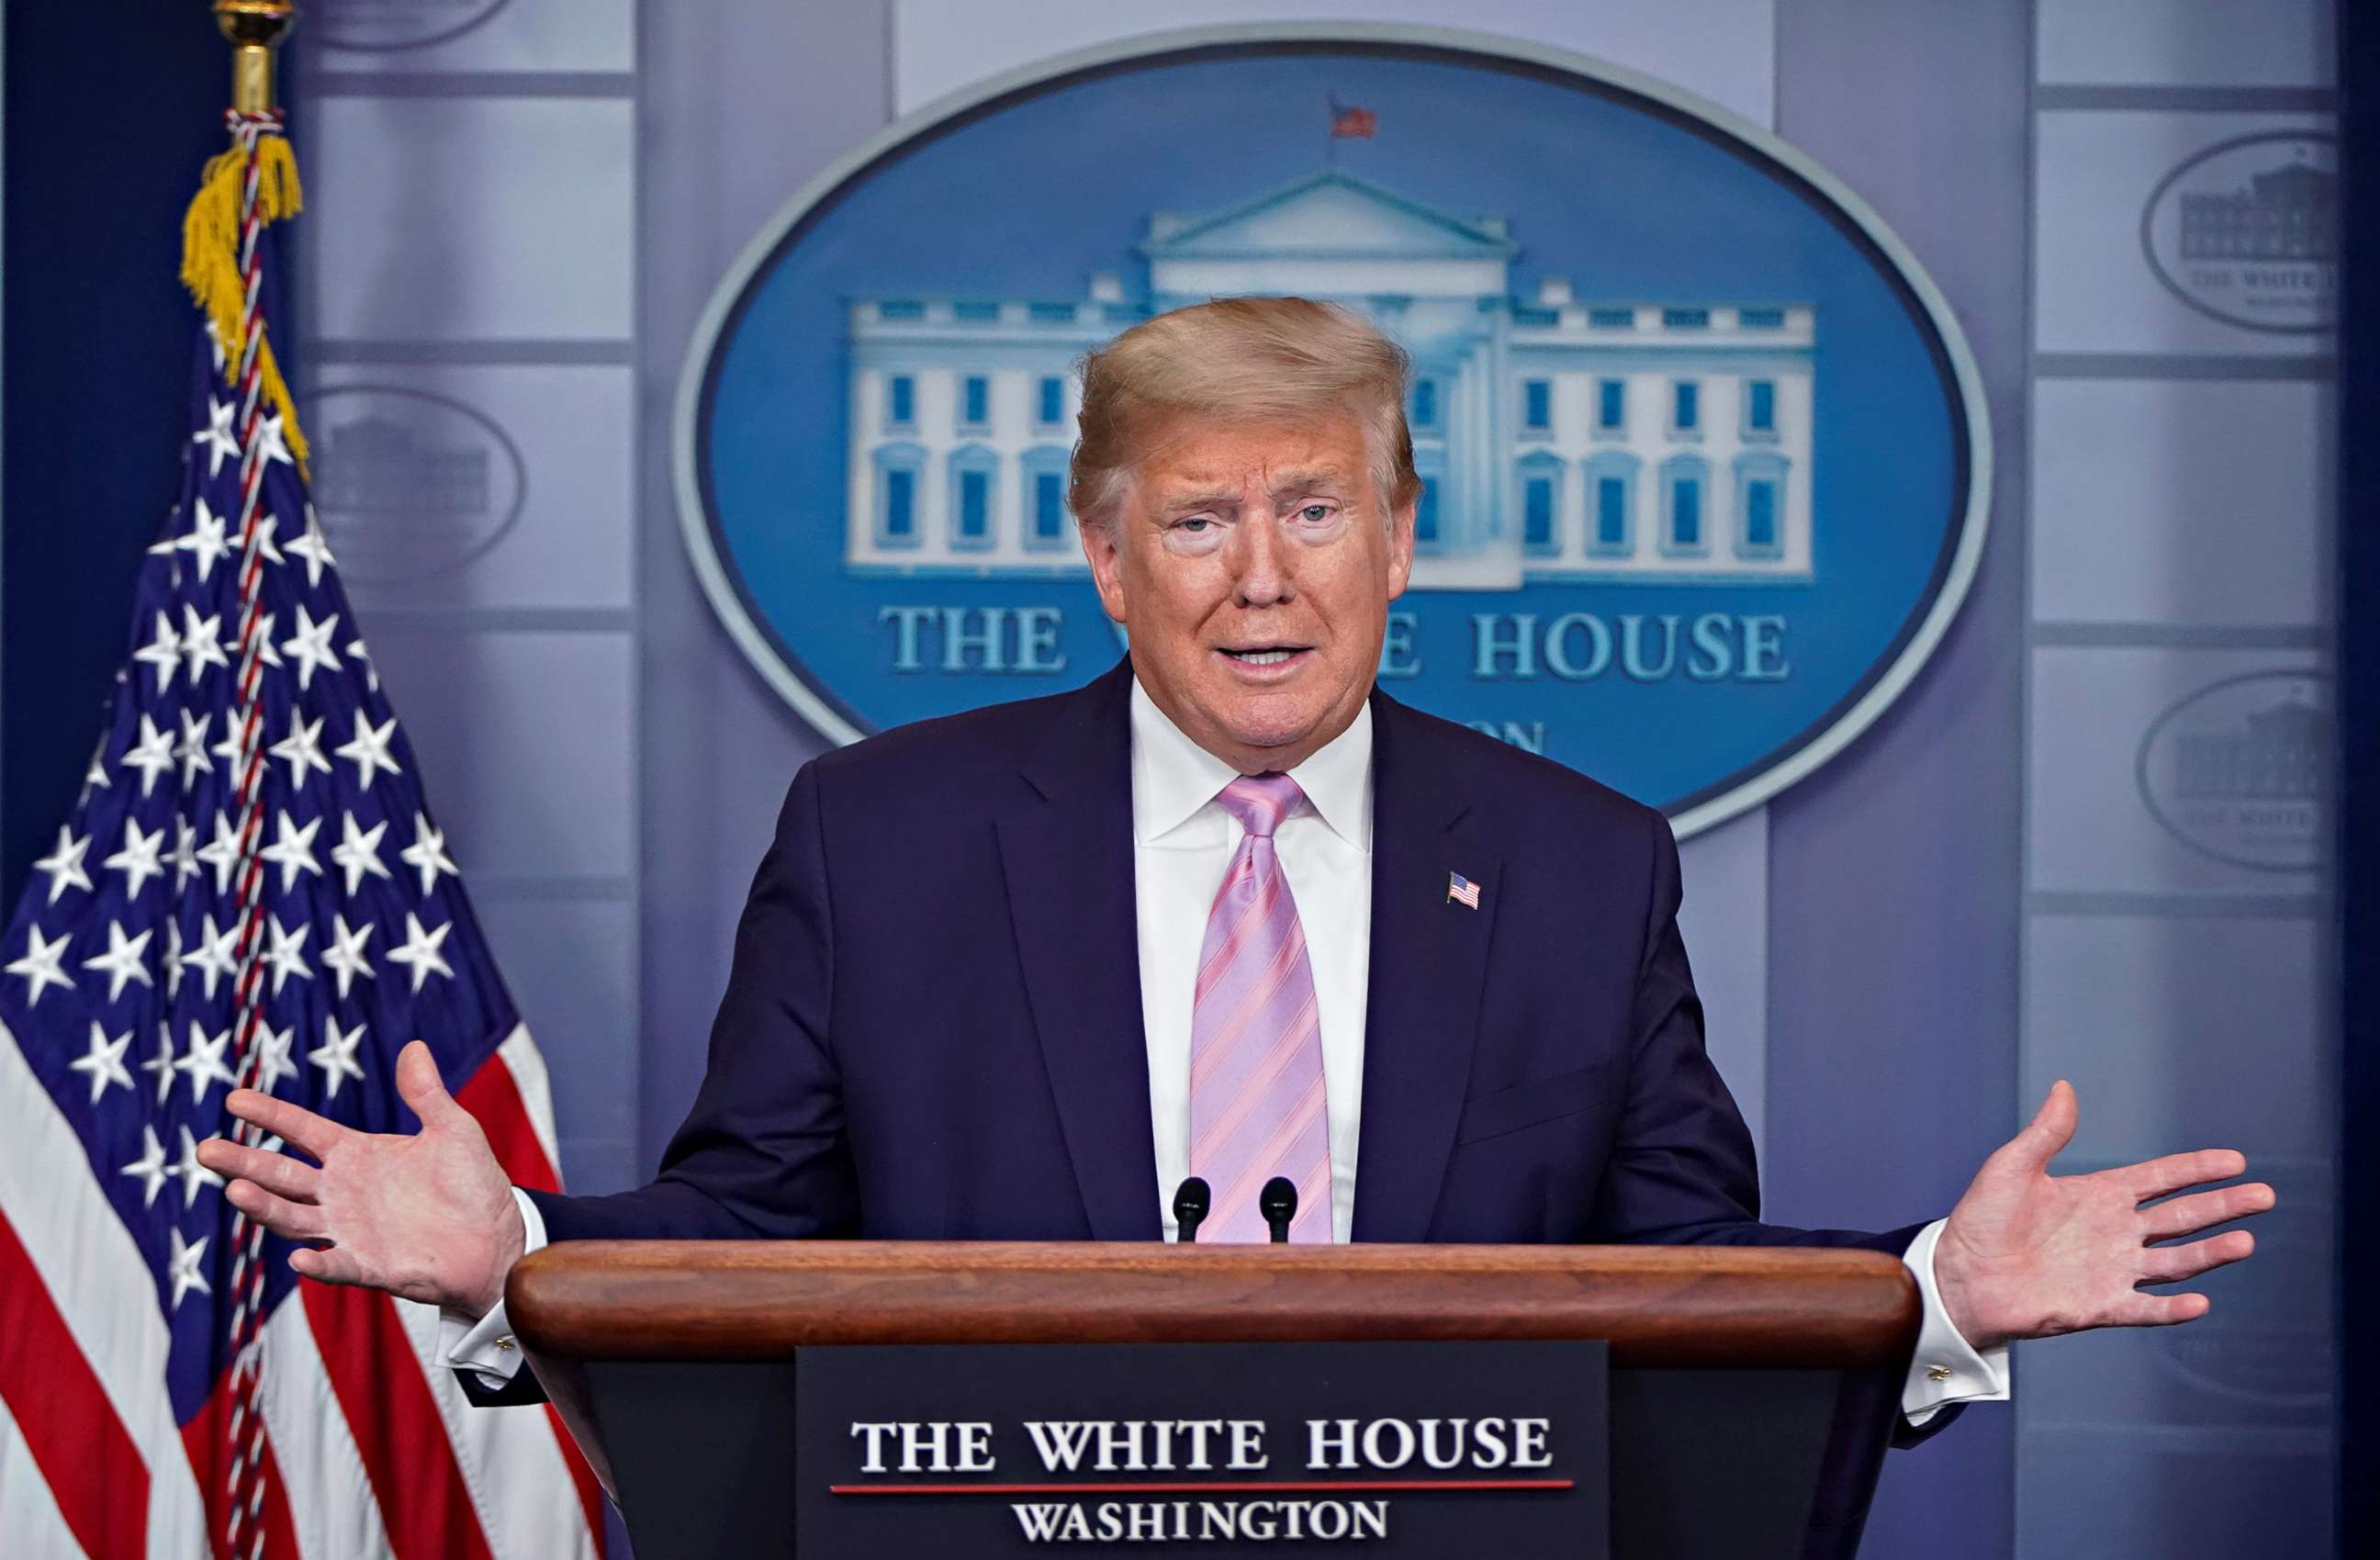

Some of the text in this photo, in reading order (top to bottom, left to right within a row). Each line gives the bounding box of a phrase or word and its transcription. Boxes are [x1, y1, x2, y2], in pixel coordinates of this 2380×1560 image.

[878, 605, 1067, 672] THE
[1473, 612, 1790, 679] HOUSE
[850, 1417, 1554, 1473] THE WHITE HOUSE
[1011, 1500, 1389, 1543] WASHINGTON
